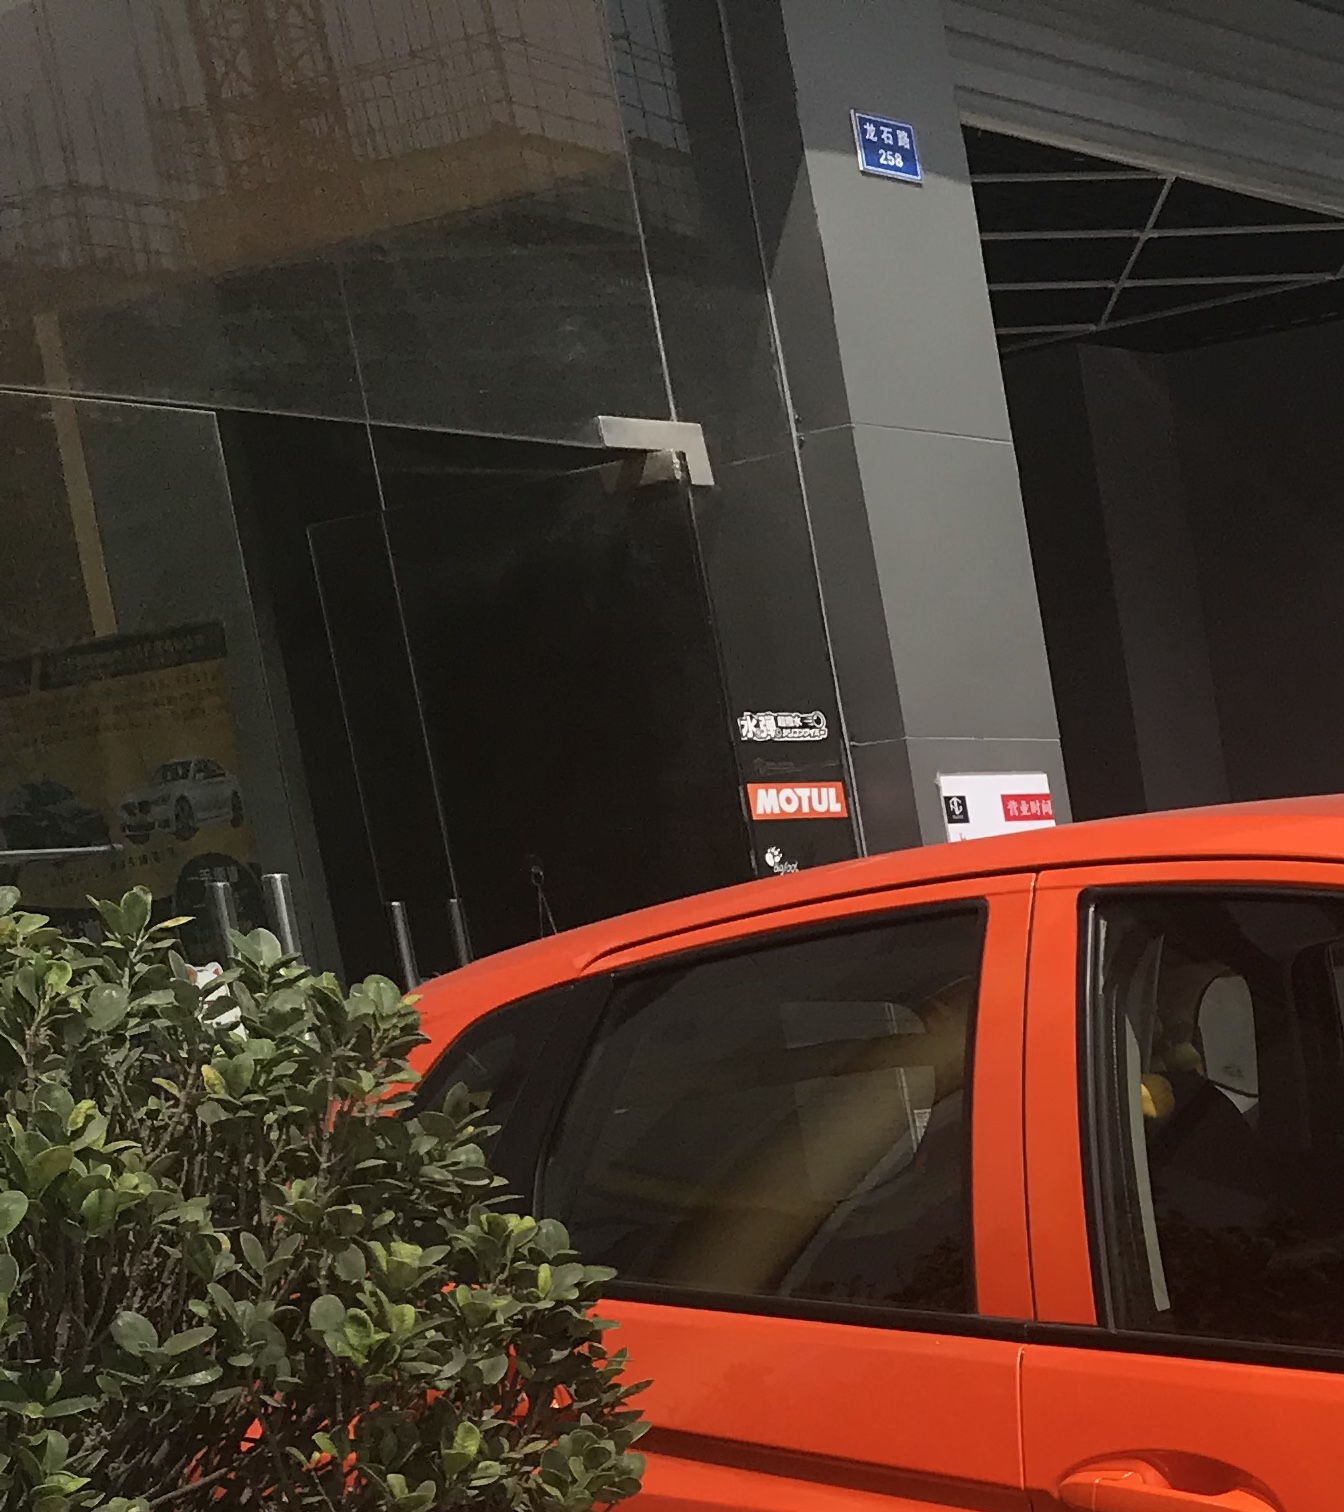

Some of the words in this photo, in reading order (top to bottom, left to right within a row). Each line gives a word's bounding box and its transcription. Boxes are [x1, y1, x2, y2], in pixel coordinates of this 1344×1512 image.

[878, 148, 904, 168] 258
[756, 787, 842, 815] MOTUL
[1006, 799, 1053, 817] 营业时间
